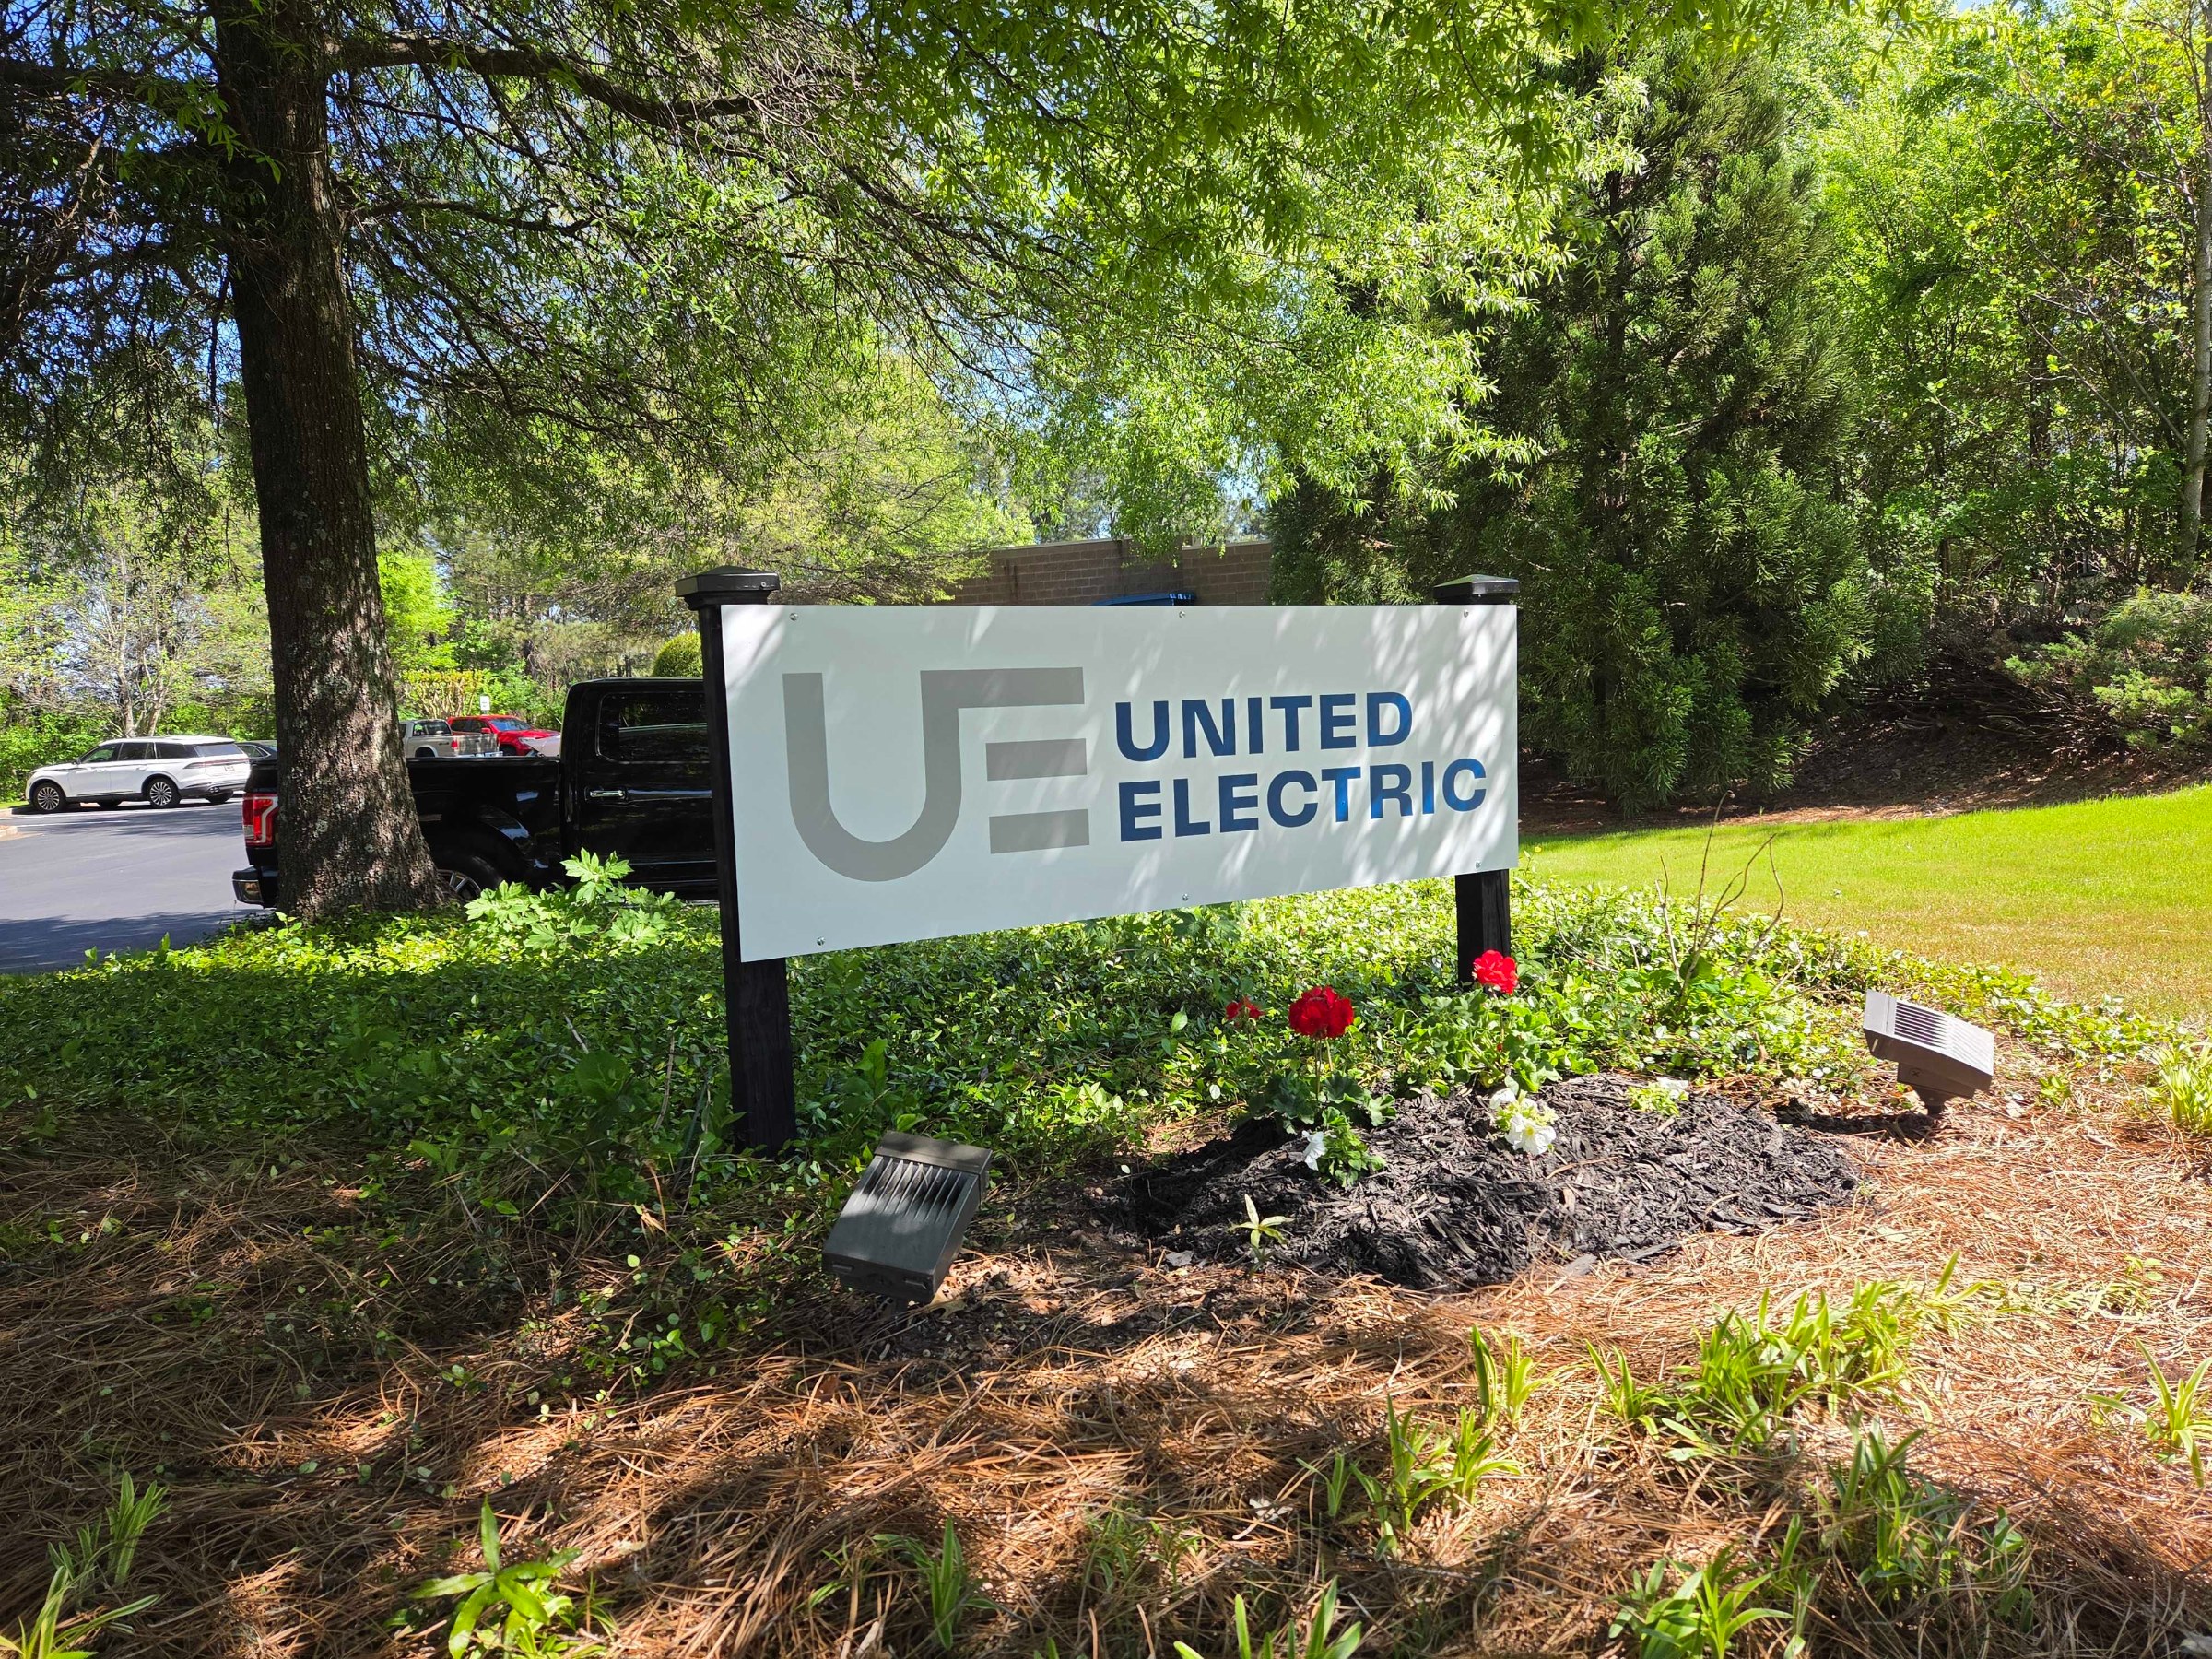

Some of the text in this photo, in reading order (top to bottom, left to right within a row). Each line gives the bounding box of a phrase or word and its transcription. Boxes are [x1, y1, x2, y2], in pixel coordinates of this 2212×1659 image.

[1115, 691, 1413, 762] UNITED
[782, 666, 1090, 882] UE
[1118, 758, 1487, 842] ELECTRIC
